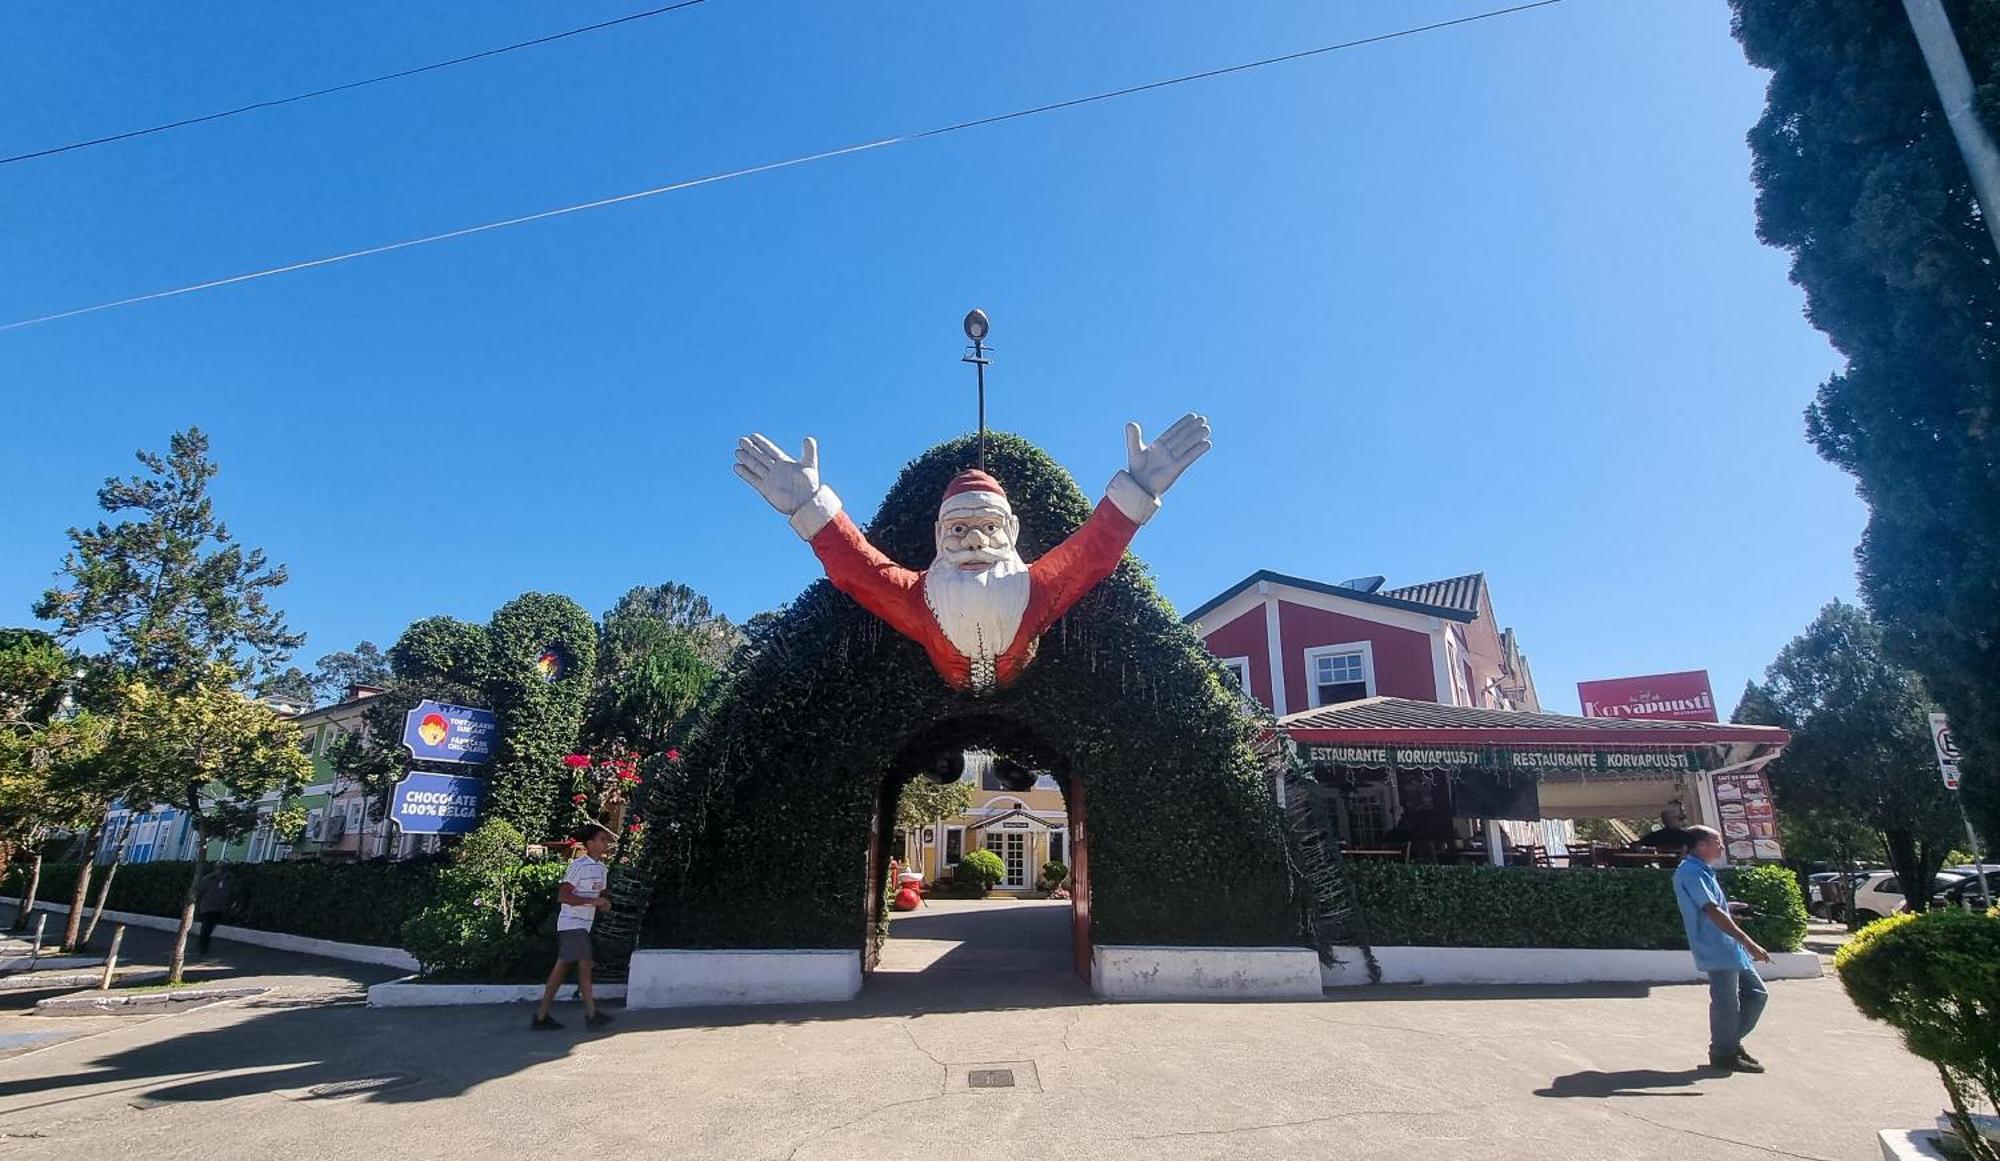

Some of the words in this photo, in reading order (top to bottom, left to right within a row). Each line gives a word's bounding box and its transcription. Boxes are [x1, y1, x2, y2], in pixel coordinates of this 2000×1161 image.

[1584, 691, 1711, 718] Korvapuusti
[1311, 747, 1386, 762] ESTAURANTE
[1397, 750, 1478, 764] KORVAPUUSTI
[1513, 752, 1597, 767] RESTAURANTE
[1607, 753, 1688, 768] KORVAPUUSTI
[406, 791, 478, 806] CHOCOLATE
[400, 803, 437, 816] 100%
[438, 805, 476, 818] BELGA
